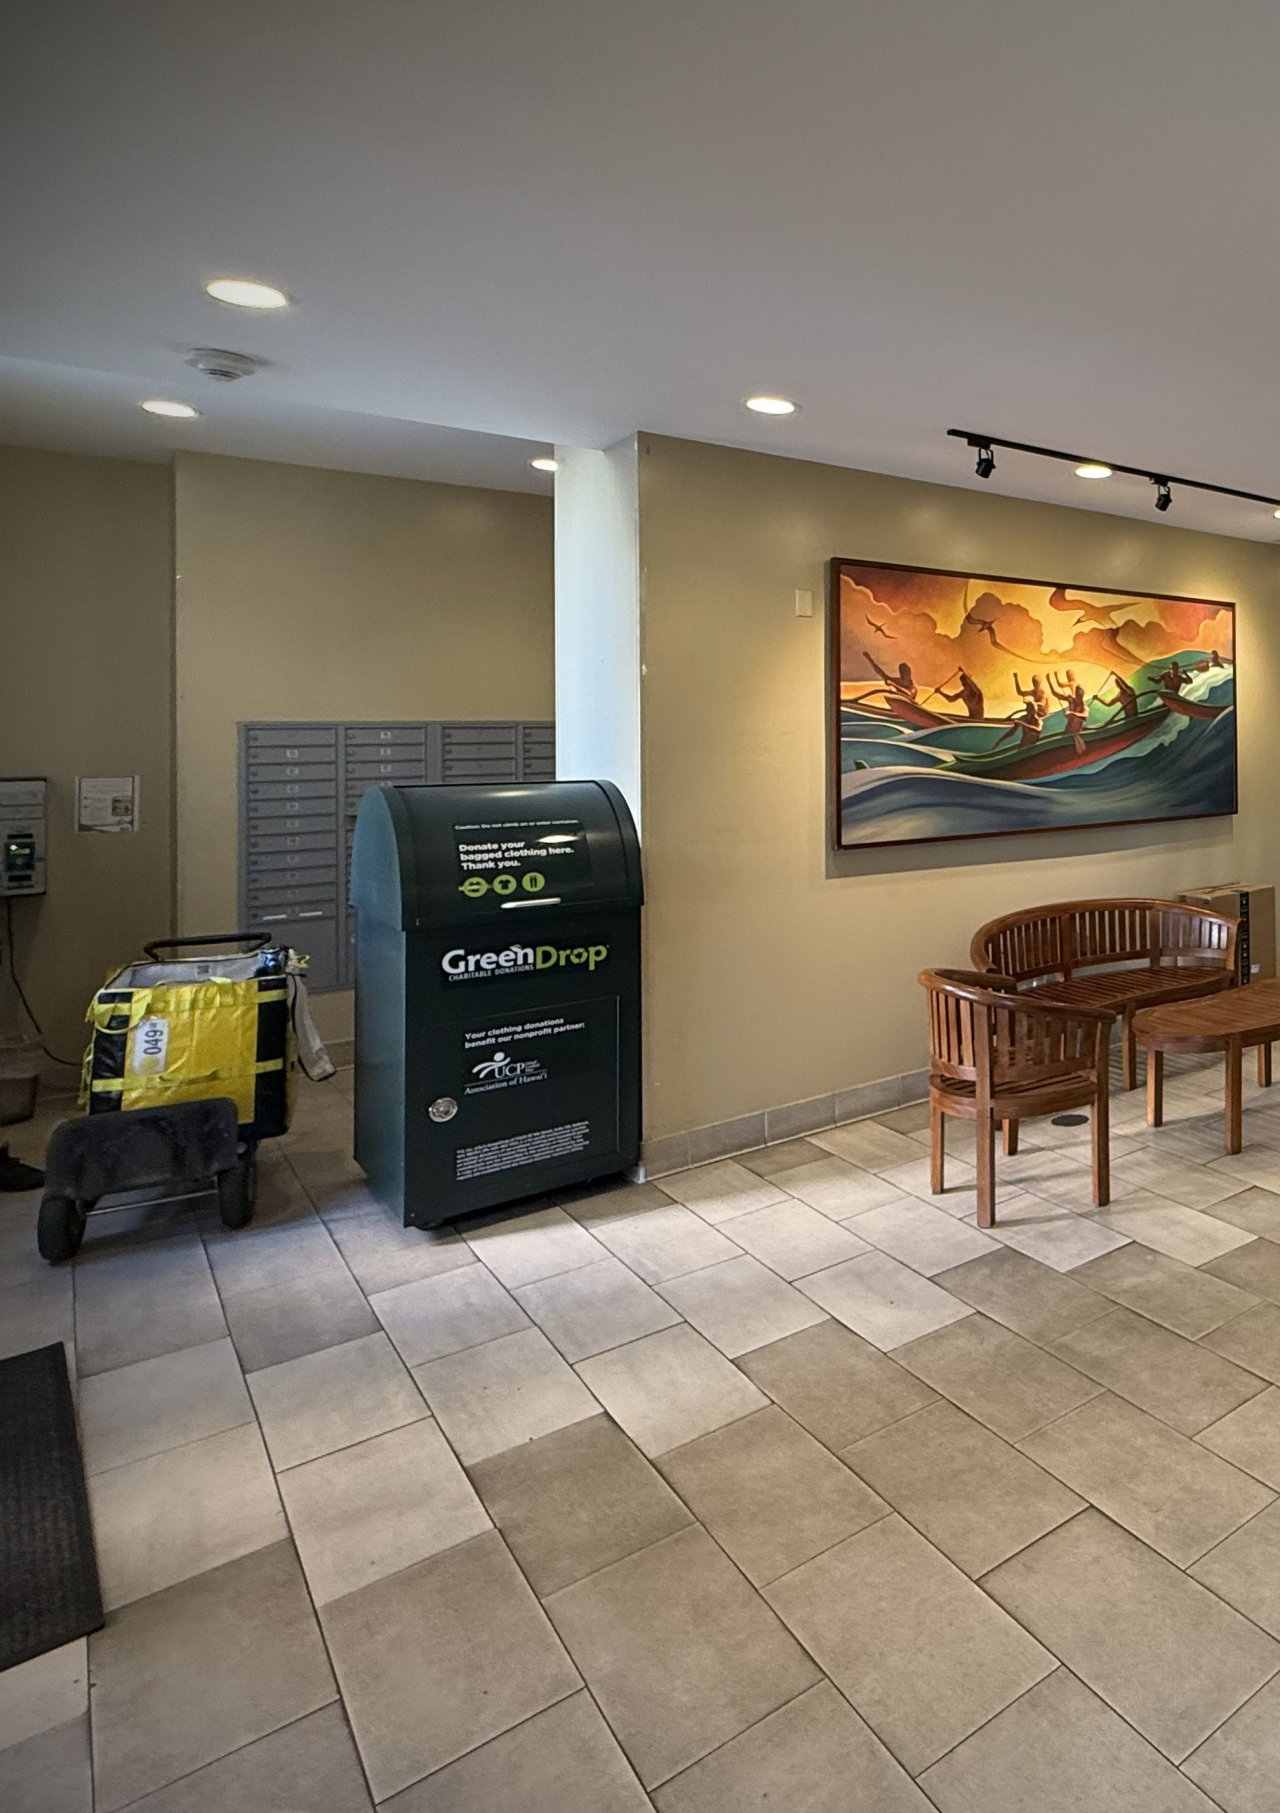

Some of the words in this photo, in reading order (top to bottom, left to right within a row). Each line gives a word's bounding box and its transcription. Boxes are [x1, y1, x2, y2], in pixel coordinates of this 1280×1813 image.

[459, 843, 499, 852] Donate
[500, 841, 525, 851] your
[460, 851, 502, 861] bagged
[504, 847, 547, 858] clothing
[548, 846, 574, 855] here.
[461, 860, 496, 870] Thank
[497, 859, 521, 870] you.
[441, 944, 608, 974] GreenDrop
[449, 970, 492, 982] CHARITABLE
[494, 964, 534, 976] DONATIONS
[464, 1031, 486, 1041] Your
[487, 1025, 522, 1037] clothing
[523, 1018, 564, 1030] donations
[464, 1037, 496, 1049] benefit
[497, 1035, 513, 1043] our
[513, 1028, 552, 1040] nonprofit
[143, 1030, 164, 1056] 049
[495, 1062, 525, 1079] UCP
[464, 1080, 508, 1095] Association
[509, 1077, 518, 1087] of
